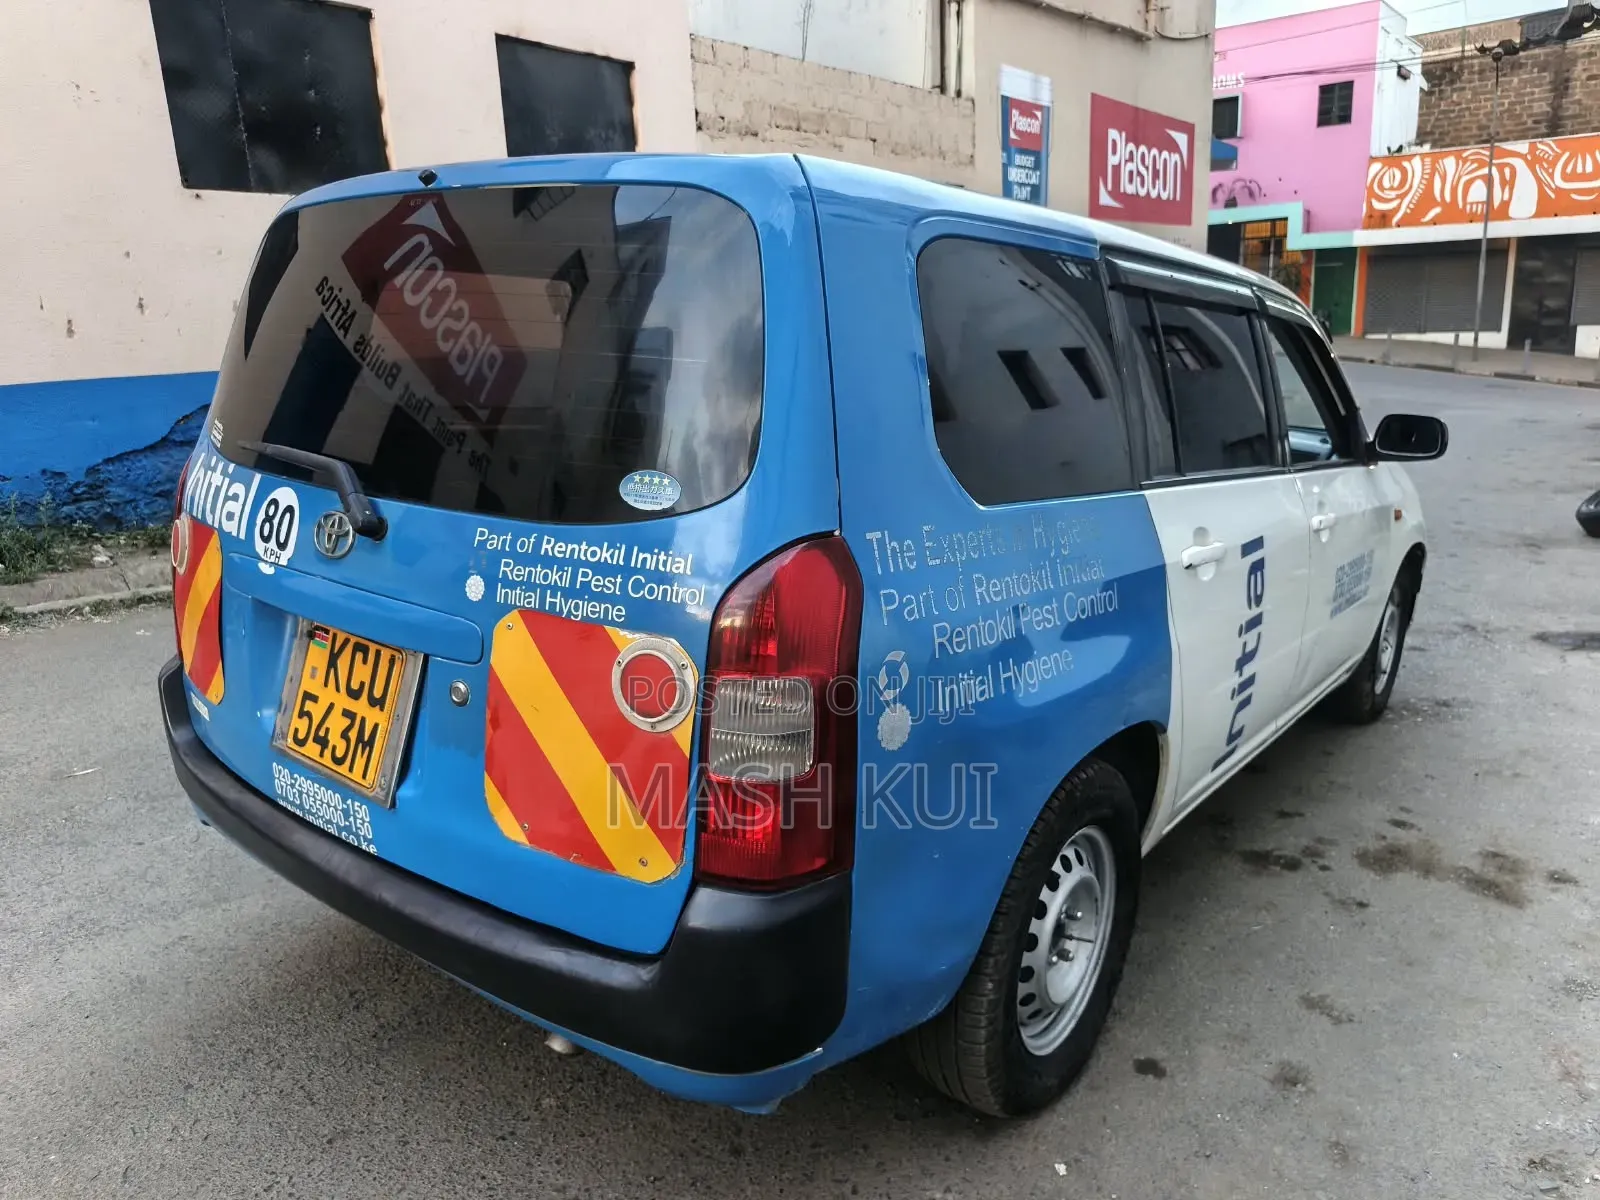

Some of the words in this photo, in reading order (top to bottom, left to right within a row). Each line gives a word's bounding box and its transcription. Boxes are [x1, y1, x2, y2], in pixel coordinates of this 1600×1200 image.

[1011, 108, 1042, 135] Plascon
[1007, 166, 1041, 185] UNDERCOAT
[1014, 153, 1036, 168] BUDGET
[1107, 128, 1182, 201] Plascon
[260, 497, 296, 552] 80
[473, 527, 512, 553] Part
[516, 533, 538, 554] of
[540, 535, 626, 566] Rentokil
[630, 545, 693, 576] Initial
[865, 530, 917, 575] The
[263, 544, 282, 564] KPH
[498, 558, 572, 588] Rentokil
[576, 567, 622, 596] Pest
[627, 575, 706, 606] Control
[546, 589, 626, 623] Hygiene
[880, 584, 939, 626] Part
[945, 575, 966, 612] of
[972, 561, 1054, 606] Rentokil
[933, 606, 1017, 659] Rentokil
[1019, 602, 1060, 636] Pest
[1063, 581, 1119, 622] Control
[323, 632, 397, 712] KCU
[937, 664, 994, 713] Initial
[999, 648, 1076, 698] Hygiene
[1210, 535, 1265, 773] Initial
[292, 690, 380, 781] 543M
[272, 761, 370, 822] 020-2995000-150
[274, 778, 300, 805] 0703
[302, 794, 373, 839] 055000-150
